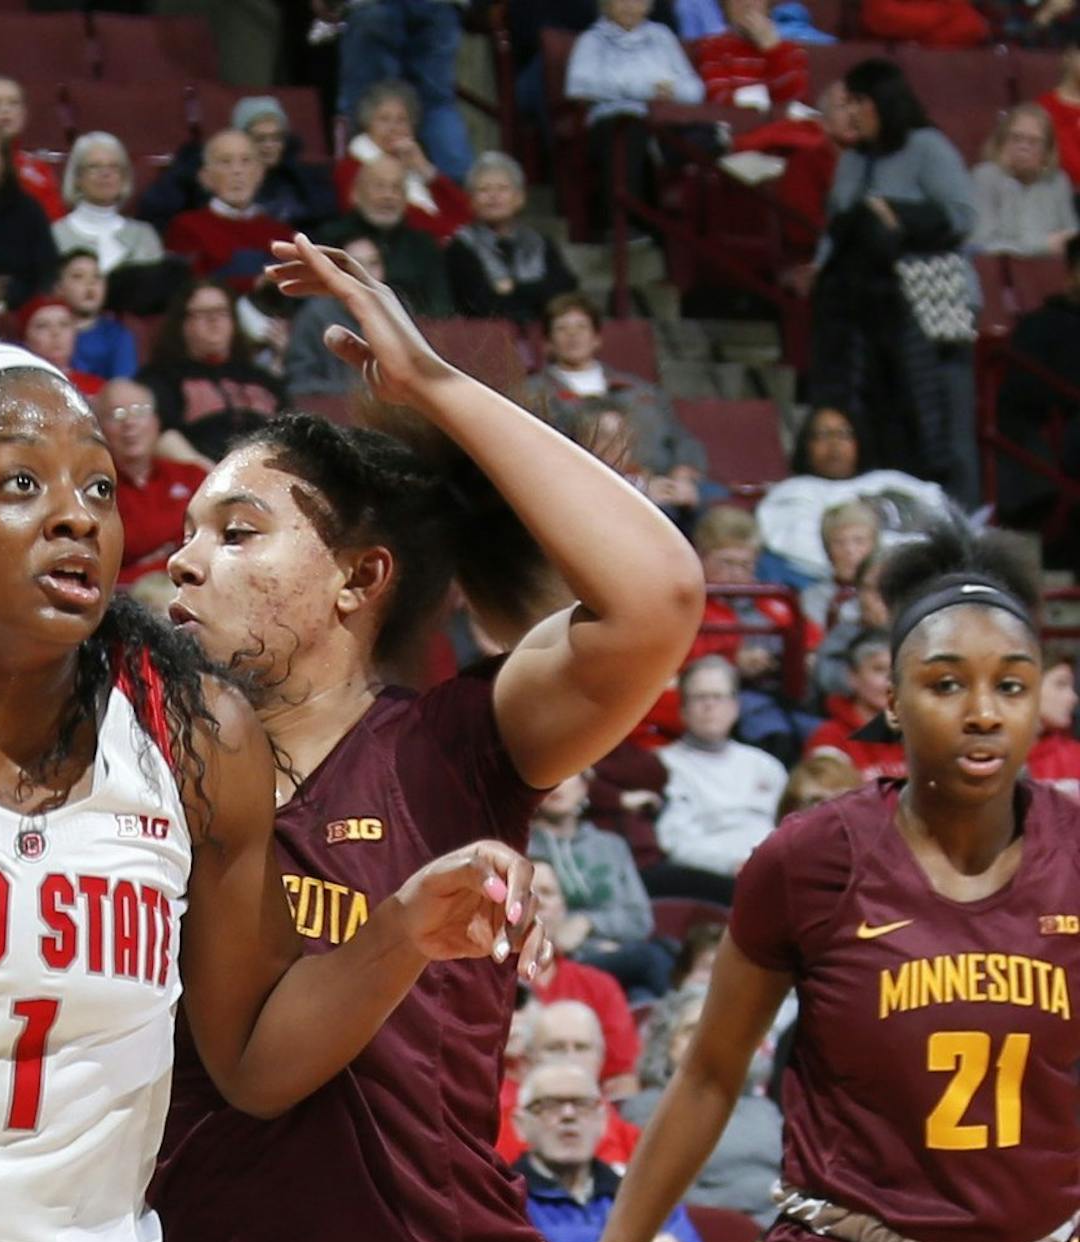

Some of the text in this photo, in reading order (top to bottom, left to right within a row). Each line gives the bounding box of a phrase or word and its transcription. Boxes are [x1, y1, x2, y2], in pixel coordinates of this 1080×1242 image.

[878, 952, 1071, 1020] MINNESOTA
[4, 997, 61, 1132] 1
[925, 1030, 1031, 1150] 21
